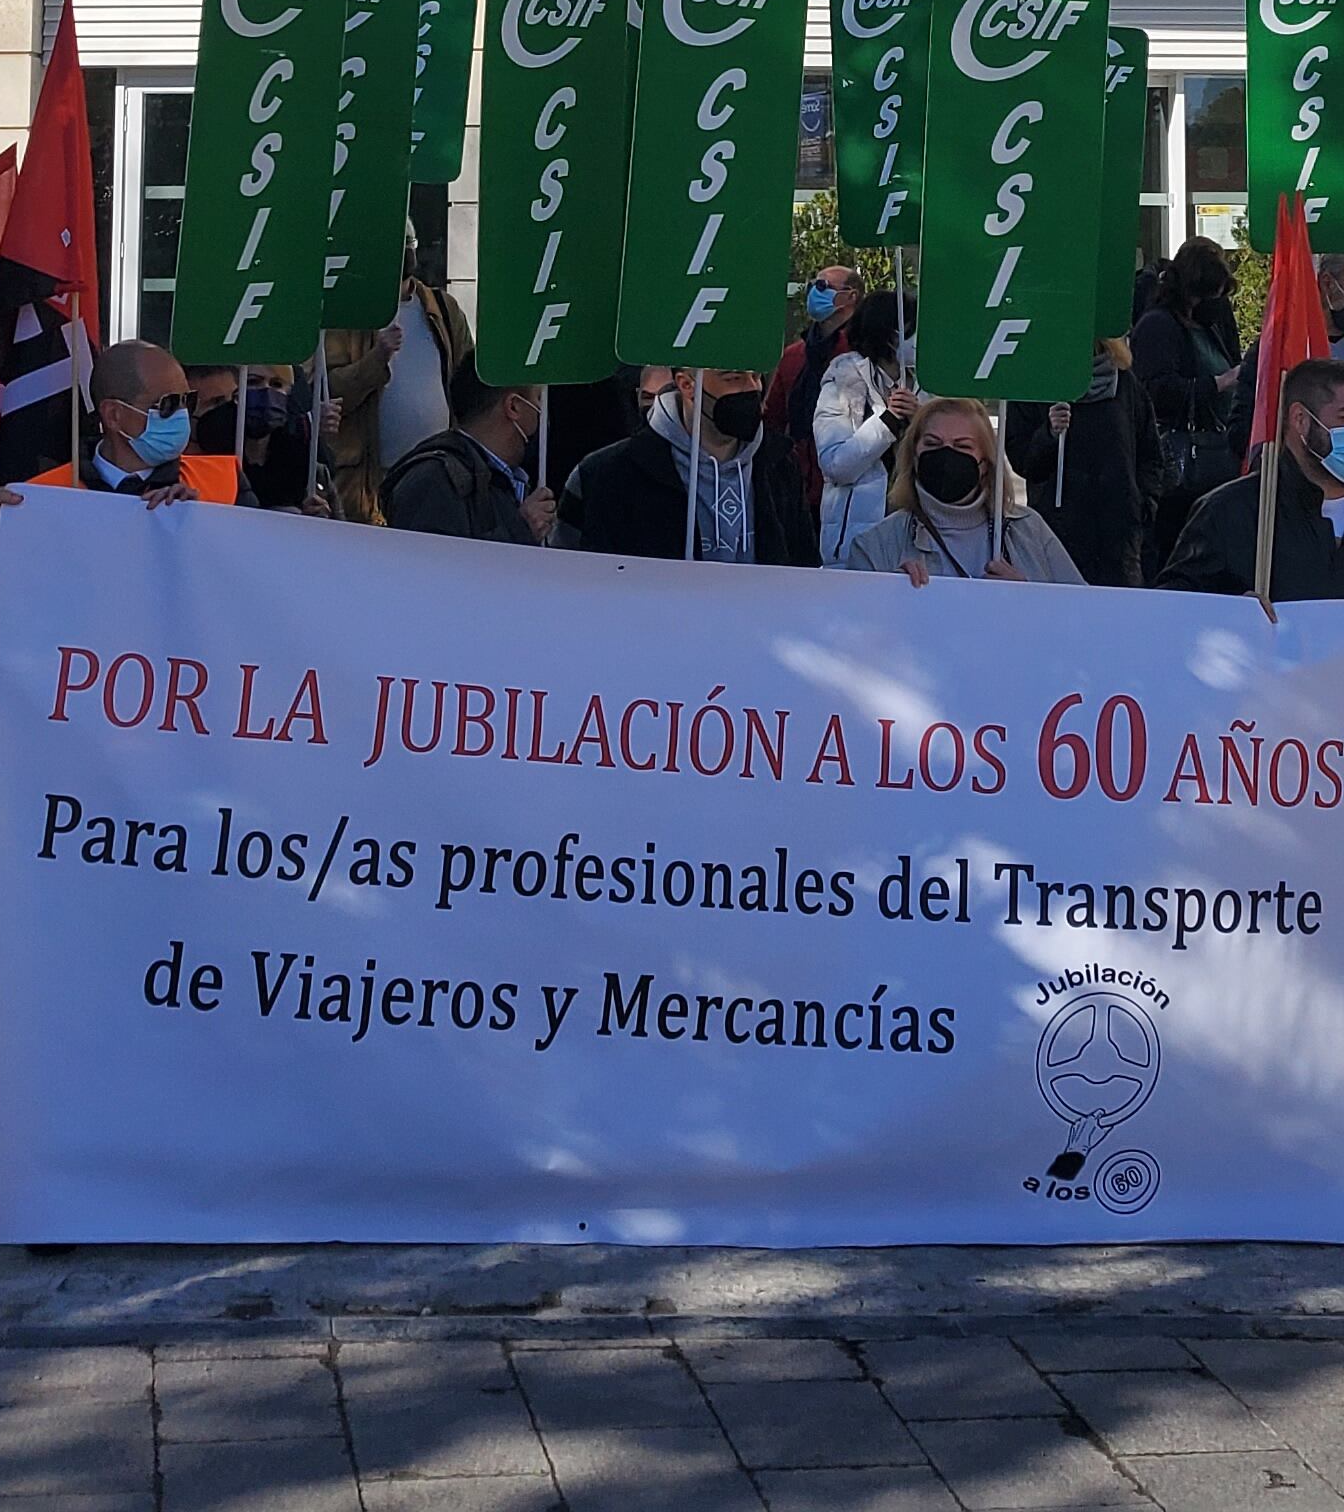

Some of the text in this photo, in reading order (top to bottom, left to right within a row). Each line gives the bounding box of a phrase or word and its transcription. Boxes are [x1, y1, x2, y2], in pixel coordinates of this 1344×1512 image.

[223, 59, 293, 345] CSIF
[526, 87, 576, 366] CSIF
[673, 68, 746, 348] CSIF
[874, 47, 907, 235] CSIF
[975, 101, 1043, 379] CSIF
[49, 647, 1344, 809] POR LA JUBILACIÓN A LOS 60 AÑOS
[38, 794, 1322, 950] Para los/as profesionales del Transporte
[144, 941, 955, 1055] de Viajeros y Mercancías
[1036, 963, 1170, 1010] Jubilación
[1022, 1166, 1143, 1201] a los 60
